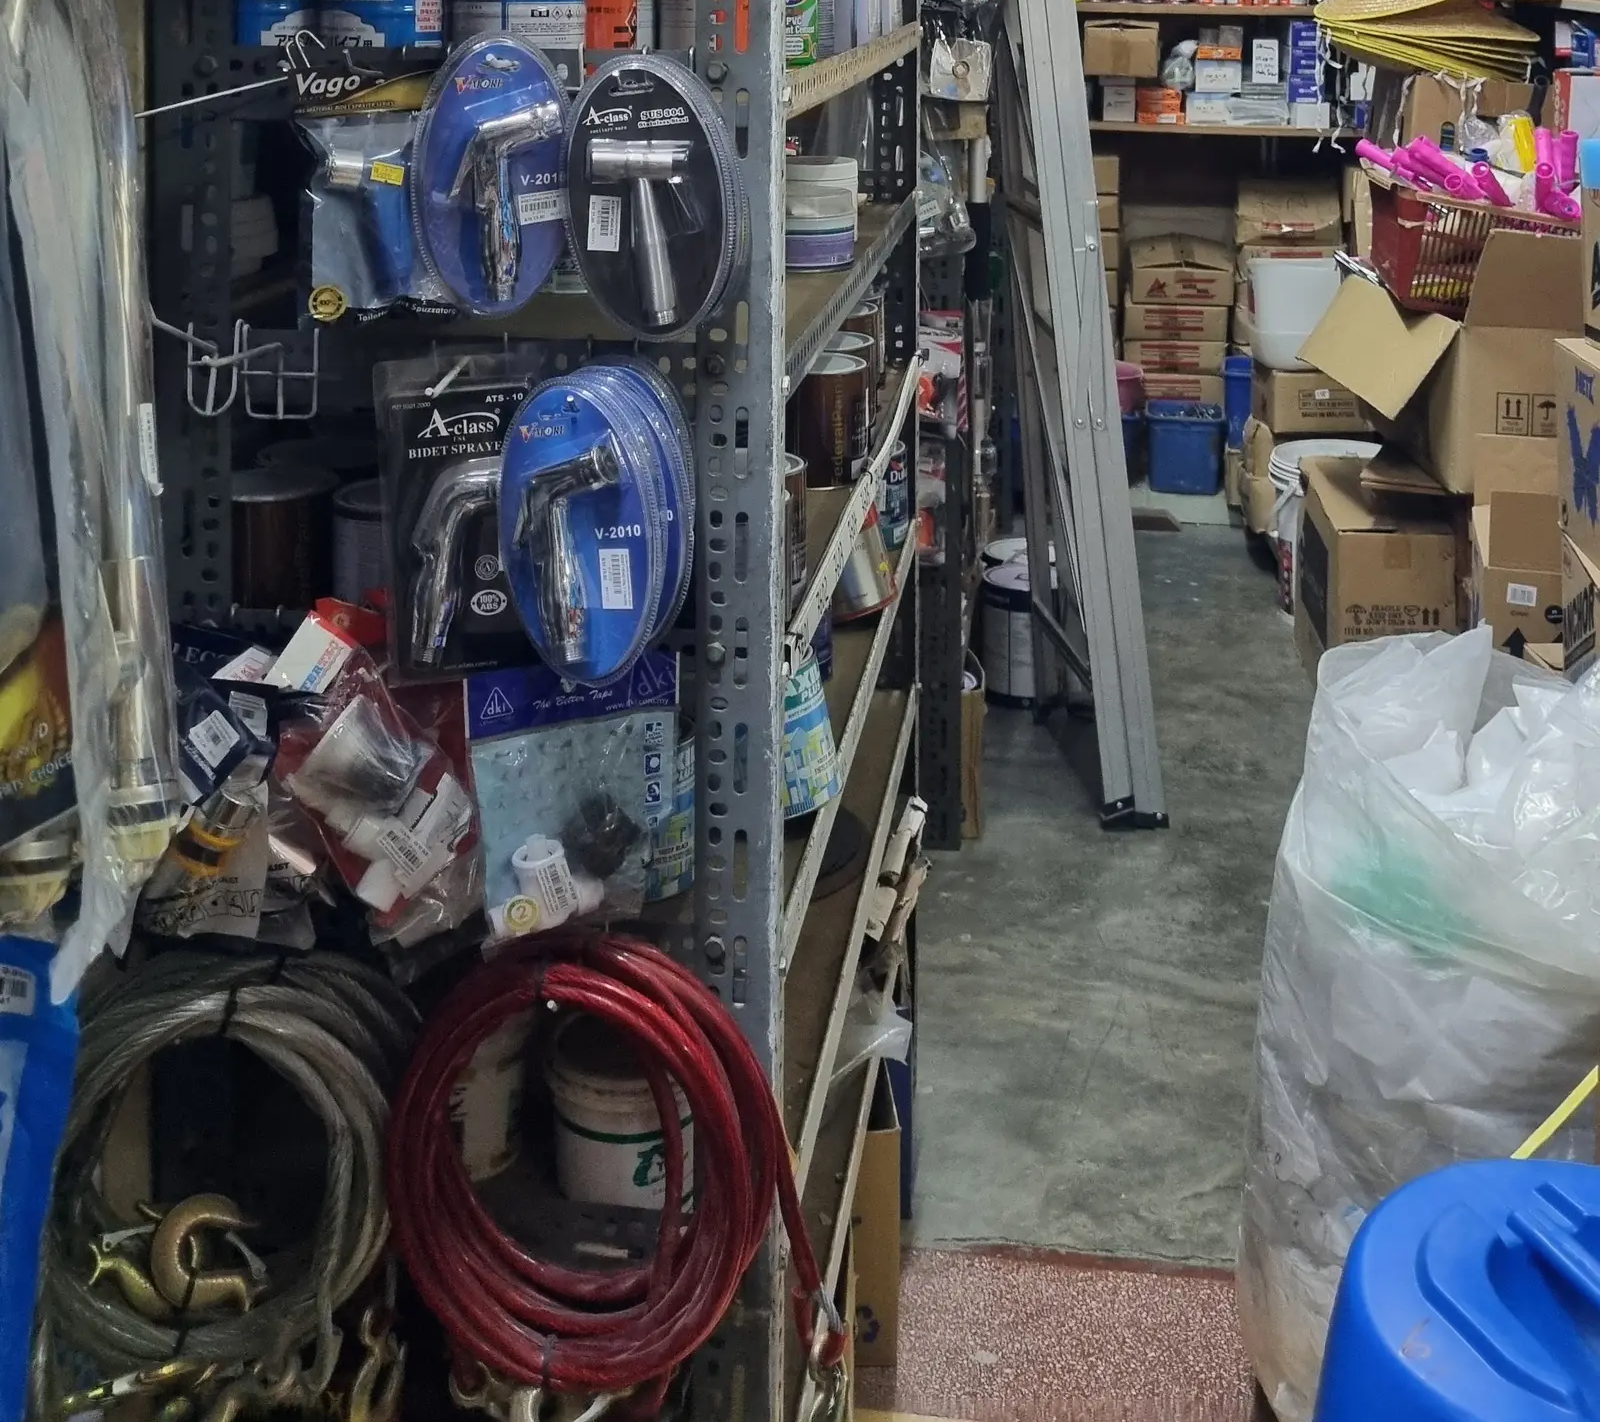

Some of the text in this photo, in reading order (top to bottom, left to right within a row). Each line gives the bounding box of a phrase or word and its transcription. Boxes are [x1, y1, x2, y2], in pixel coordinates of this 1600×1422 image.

[296, 72, 361, 98] Vago
[582, 105, 633, 126] A-class
[637, 115, 689, 129] Stainless Steel
[640, 107, 685, 121] SUS 304
[485, 393, 504, 404] ATS
[418, 407, 498, 440] A-class
[408, 444, 448, 460] BIDET
[594, 524, 641, 541] V-2010
[479, 593, 500, 604] 100%
[479, 601, 499, 612] ABS
[487, 692, 506, 716] dki
[532, 689, 613, 711] The Better Taps
